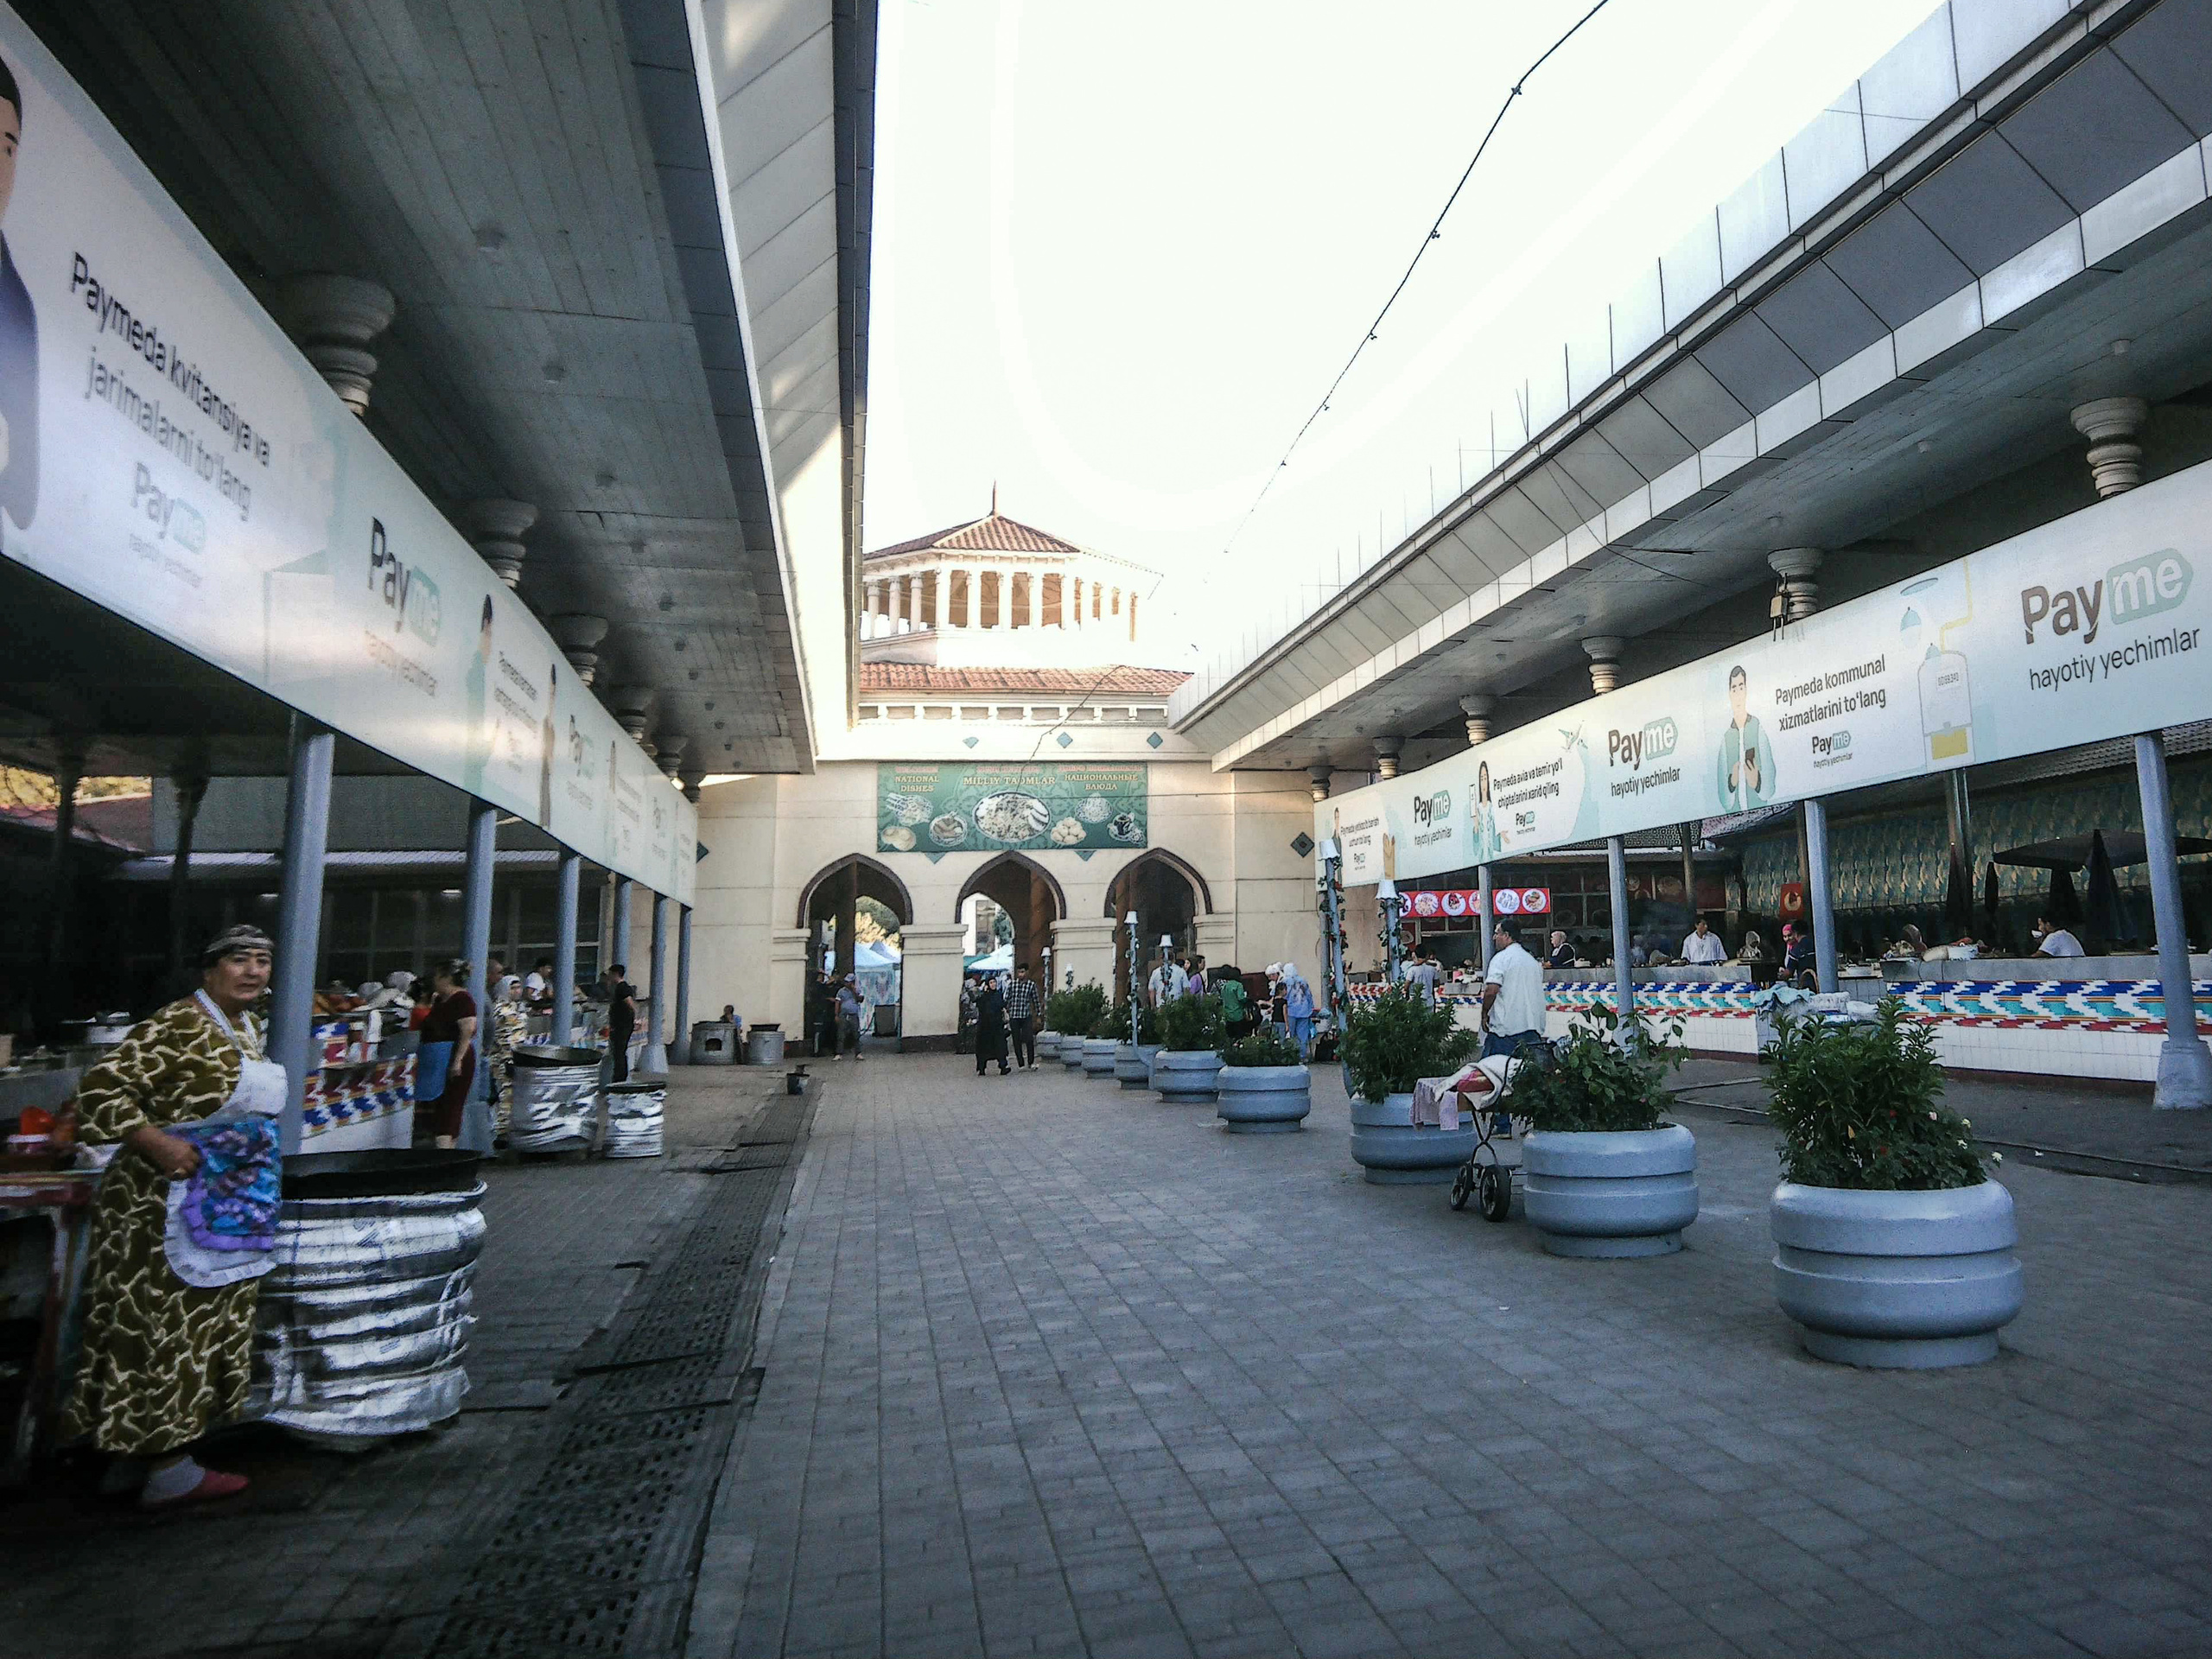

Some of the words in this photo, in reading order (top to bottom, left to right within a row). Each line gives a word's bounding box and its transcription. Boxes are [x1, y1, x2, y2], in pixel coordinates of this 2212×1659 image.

[70, 251, 166, 373] Paymeda
[170, 346, 251, 453] kvitansiya
[85, 346, 194, 466] jarimalarni
[2021, 550, 2192, 645] Payme
[2029, 654, 2095, 692] hayotiy
[2099, 628, 2200, 680] yechimlar
[1776, 677, 1823, 706] Paymeda
[1824, 654, 1885, 685] kommunal
[1779, 698, 1842, 731] xizmatlarini
[1609, 717, 1677, 771] Payme
[1812, 730, 1851, 755] Payme
[894, 775, 939, 784] NATIONAL
[963, 777, 1001, 786] MILLIY
[1004, 777, 1056, 786] TAOMLAR
[1493, 773, 1516, 792] Paymeda
[1529, 768, 1535, 779] va
[1611, 776, 1639, 798] hayotiy
[1640, 766, 1681, 794] yechimlar
[1414, 791, 1450, 827] Payme
